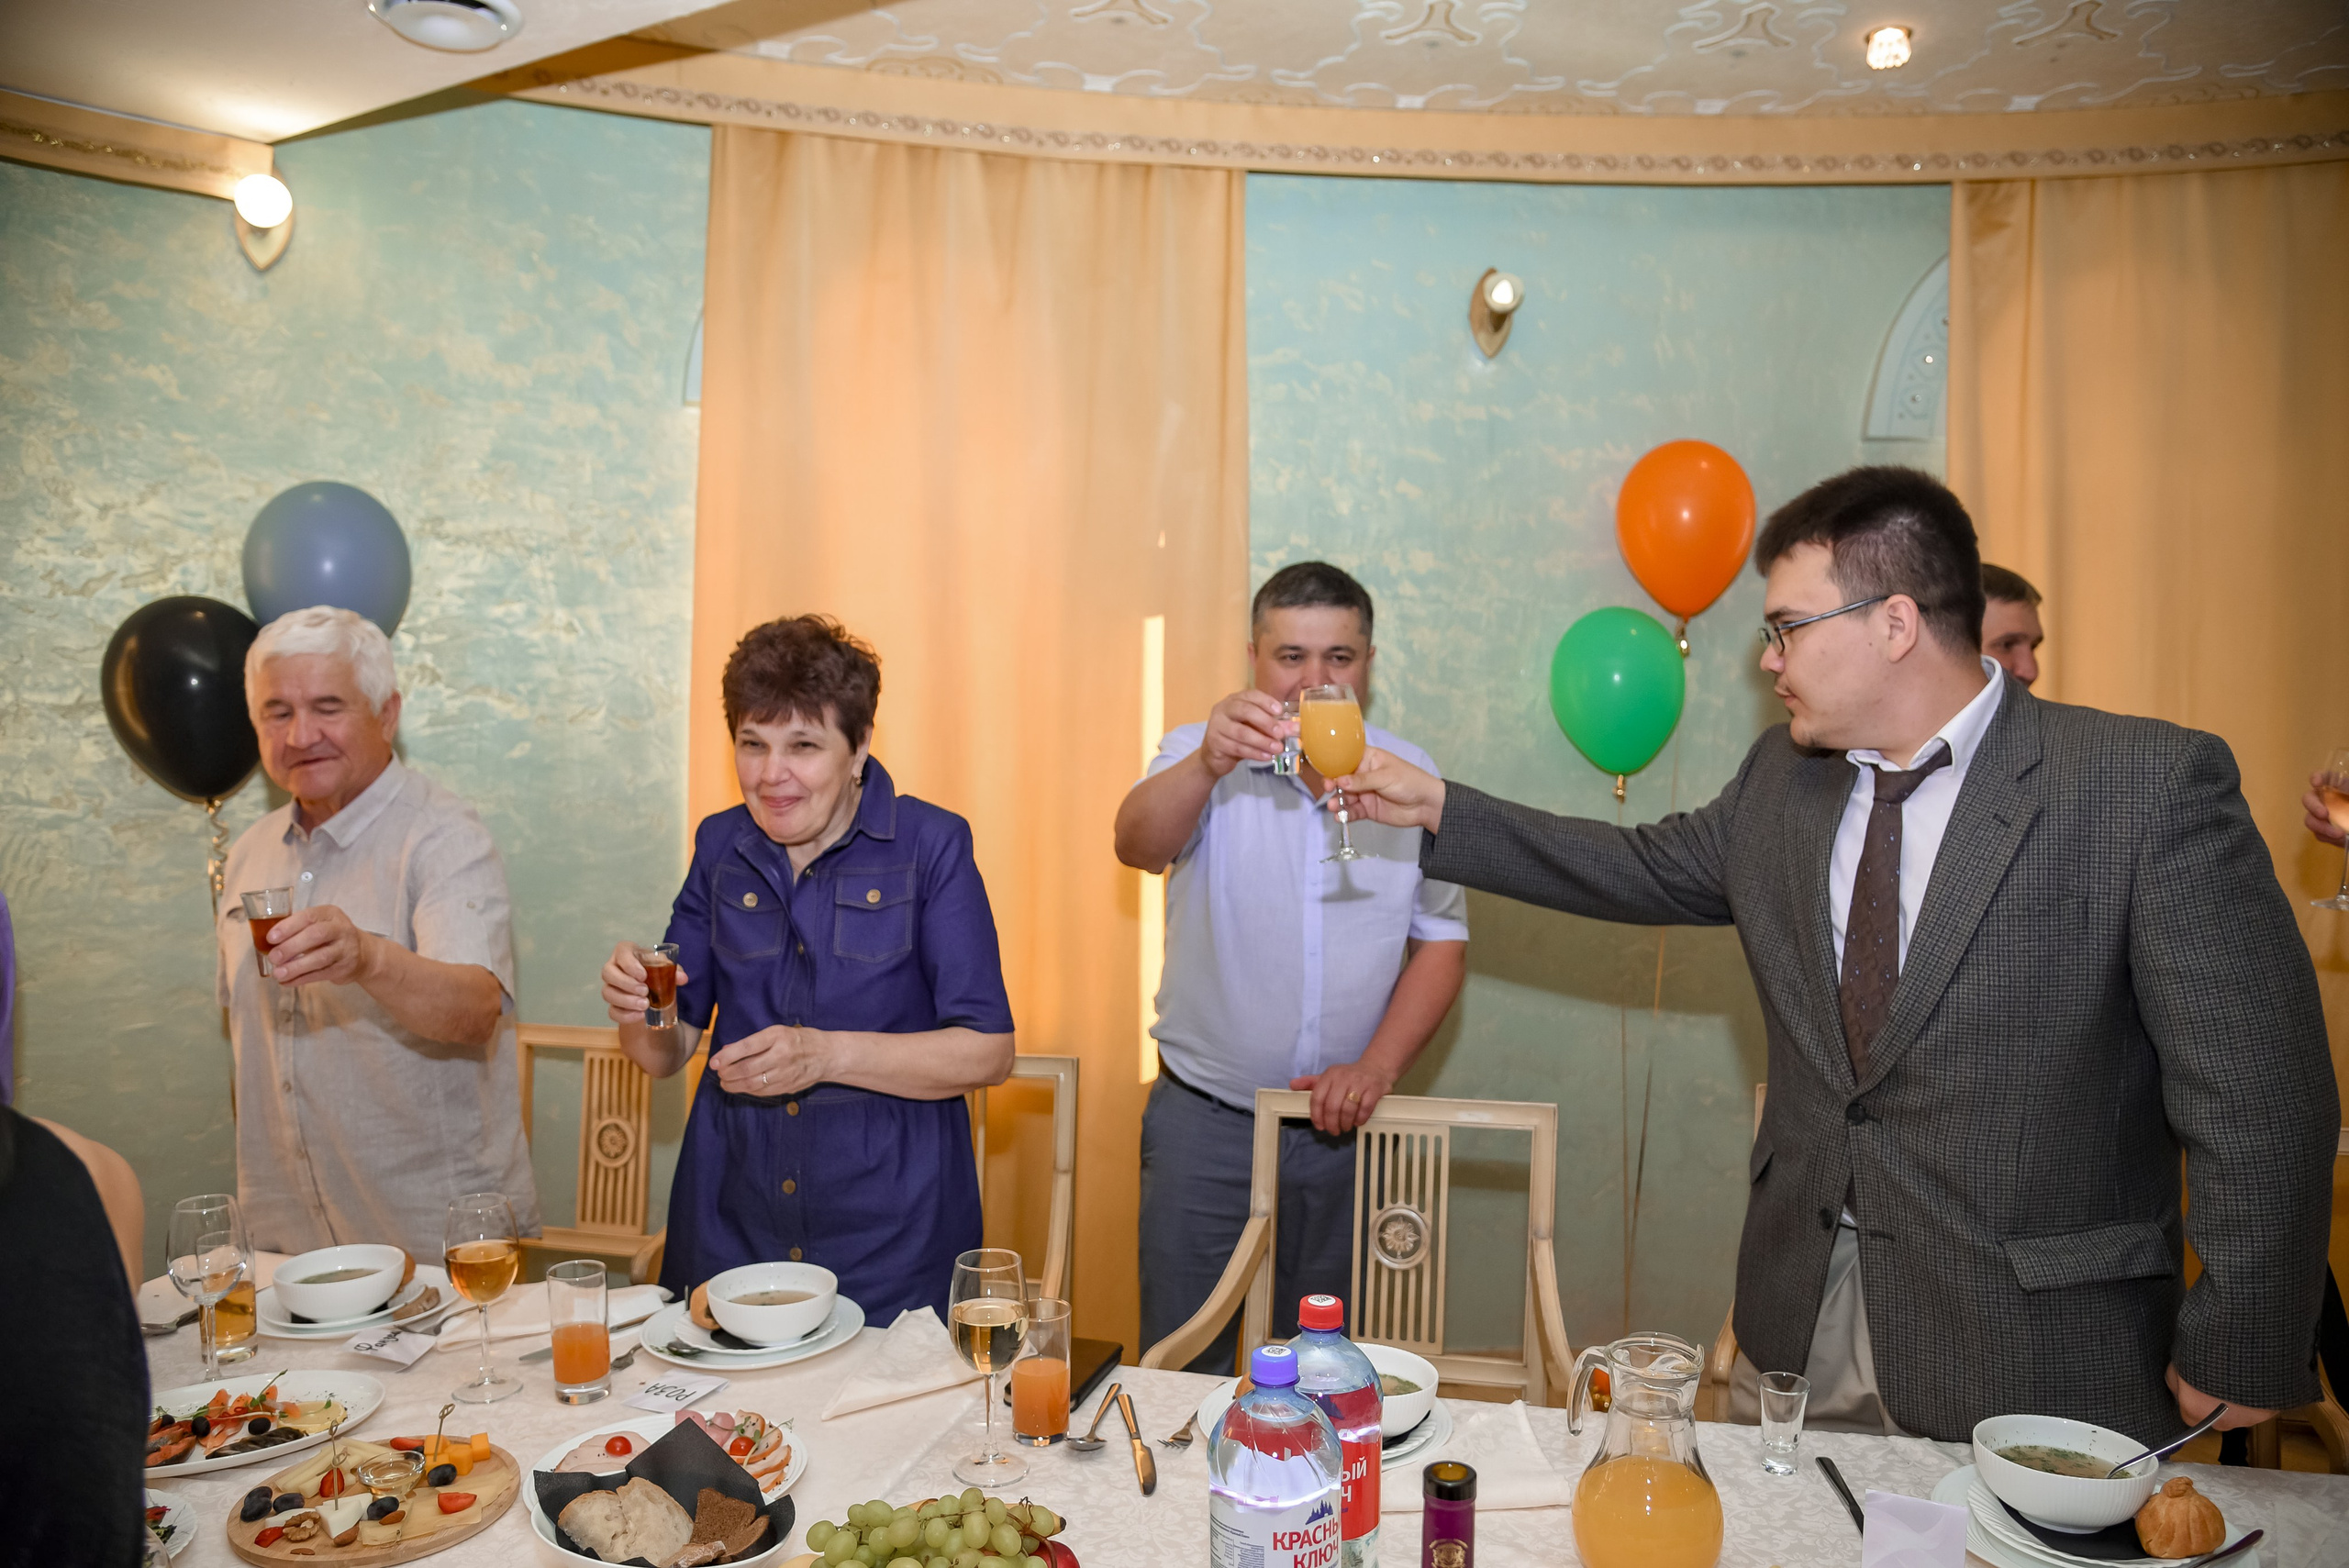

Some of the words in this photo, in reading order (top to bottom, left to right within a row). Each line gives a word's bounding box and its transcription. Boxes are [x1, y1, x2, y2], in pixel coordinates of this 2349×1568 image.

[644, 1383, 696, 1401] РОЗА
[1273, 1517, 1338, 1551] КРАСНЫ
[1293, 1536, 1339, 1568] КЛЮЧ
